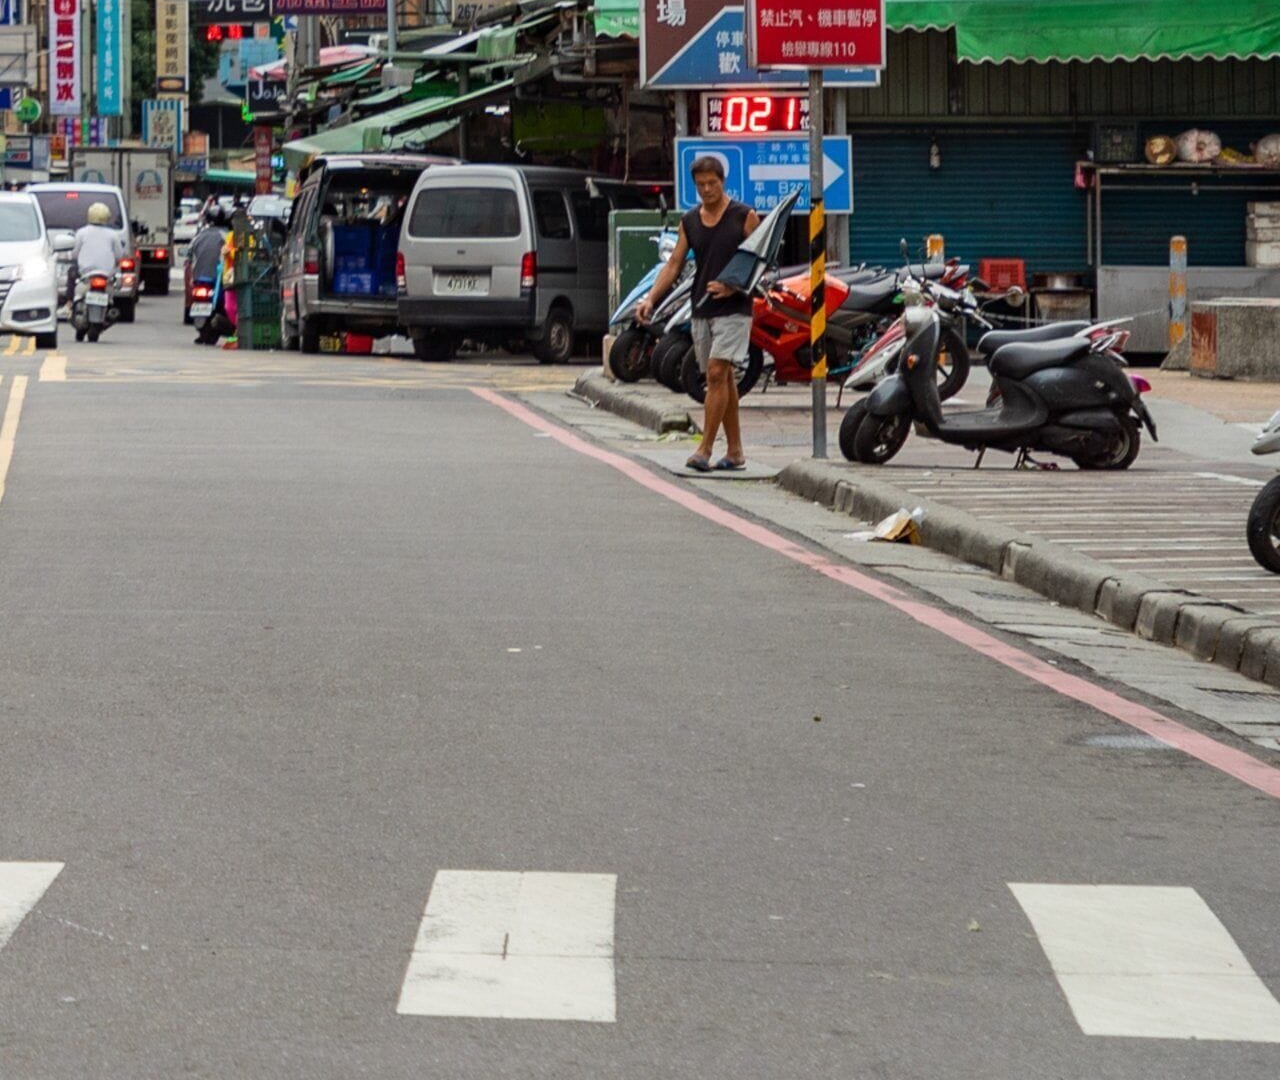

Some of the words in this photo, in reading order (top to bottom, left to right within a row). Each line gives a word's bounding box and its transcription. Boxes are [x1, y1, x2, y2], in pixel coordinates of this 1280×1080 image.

[760, 9, 877, 28] 禁止汽、機車暫停
[725, 96, 797, 132] 021
